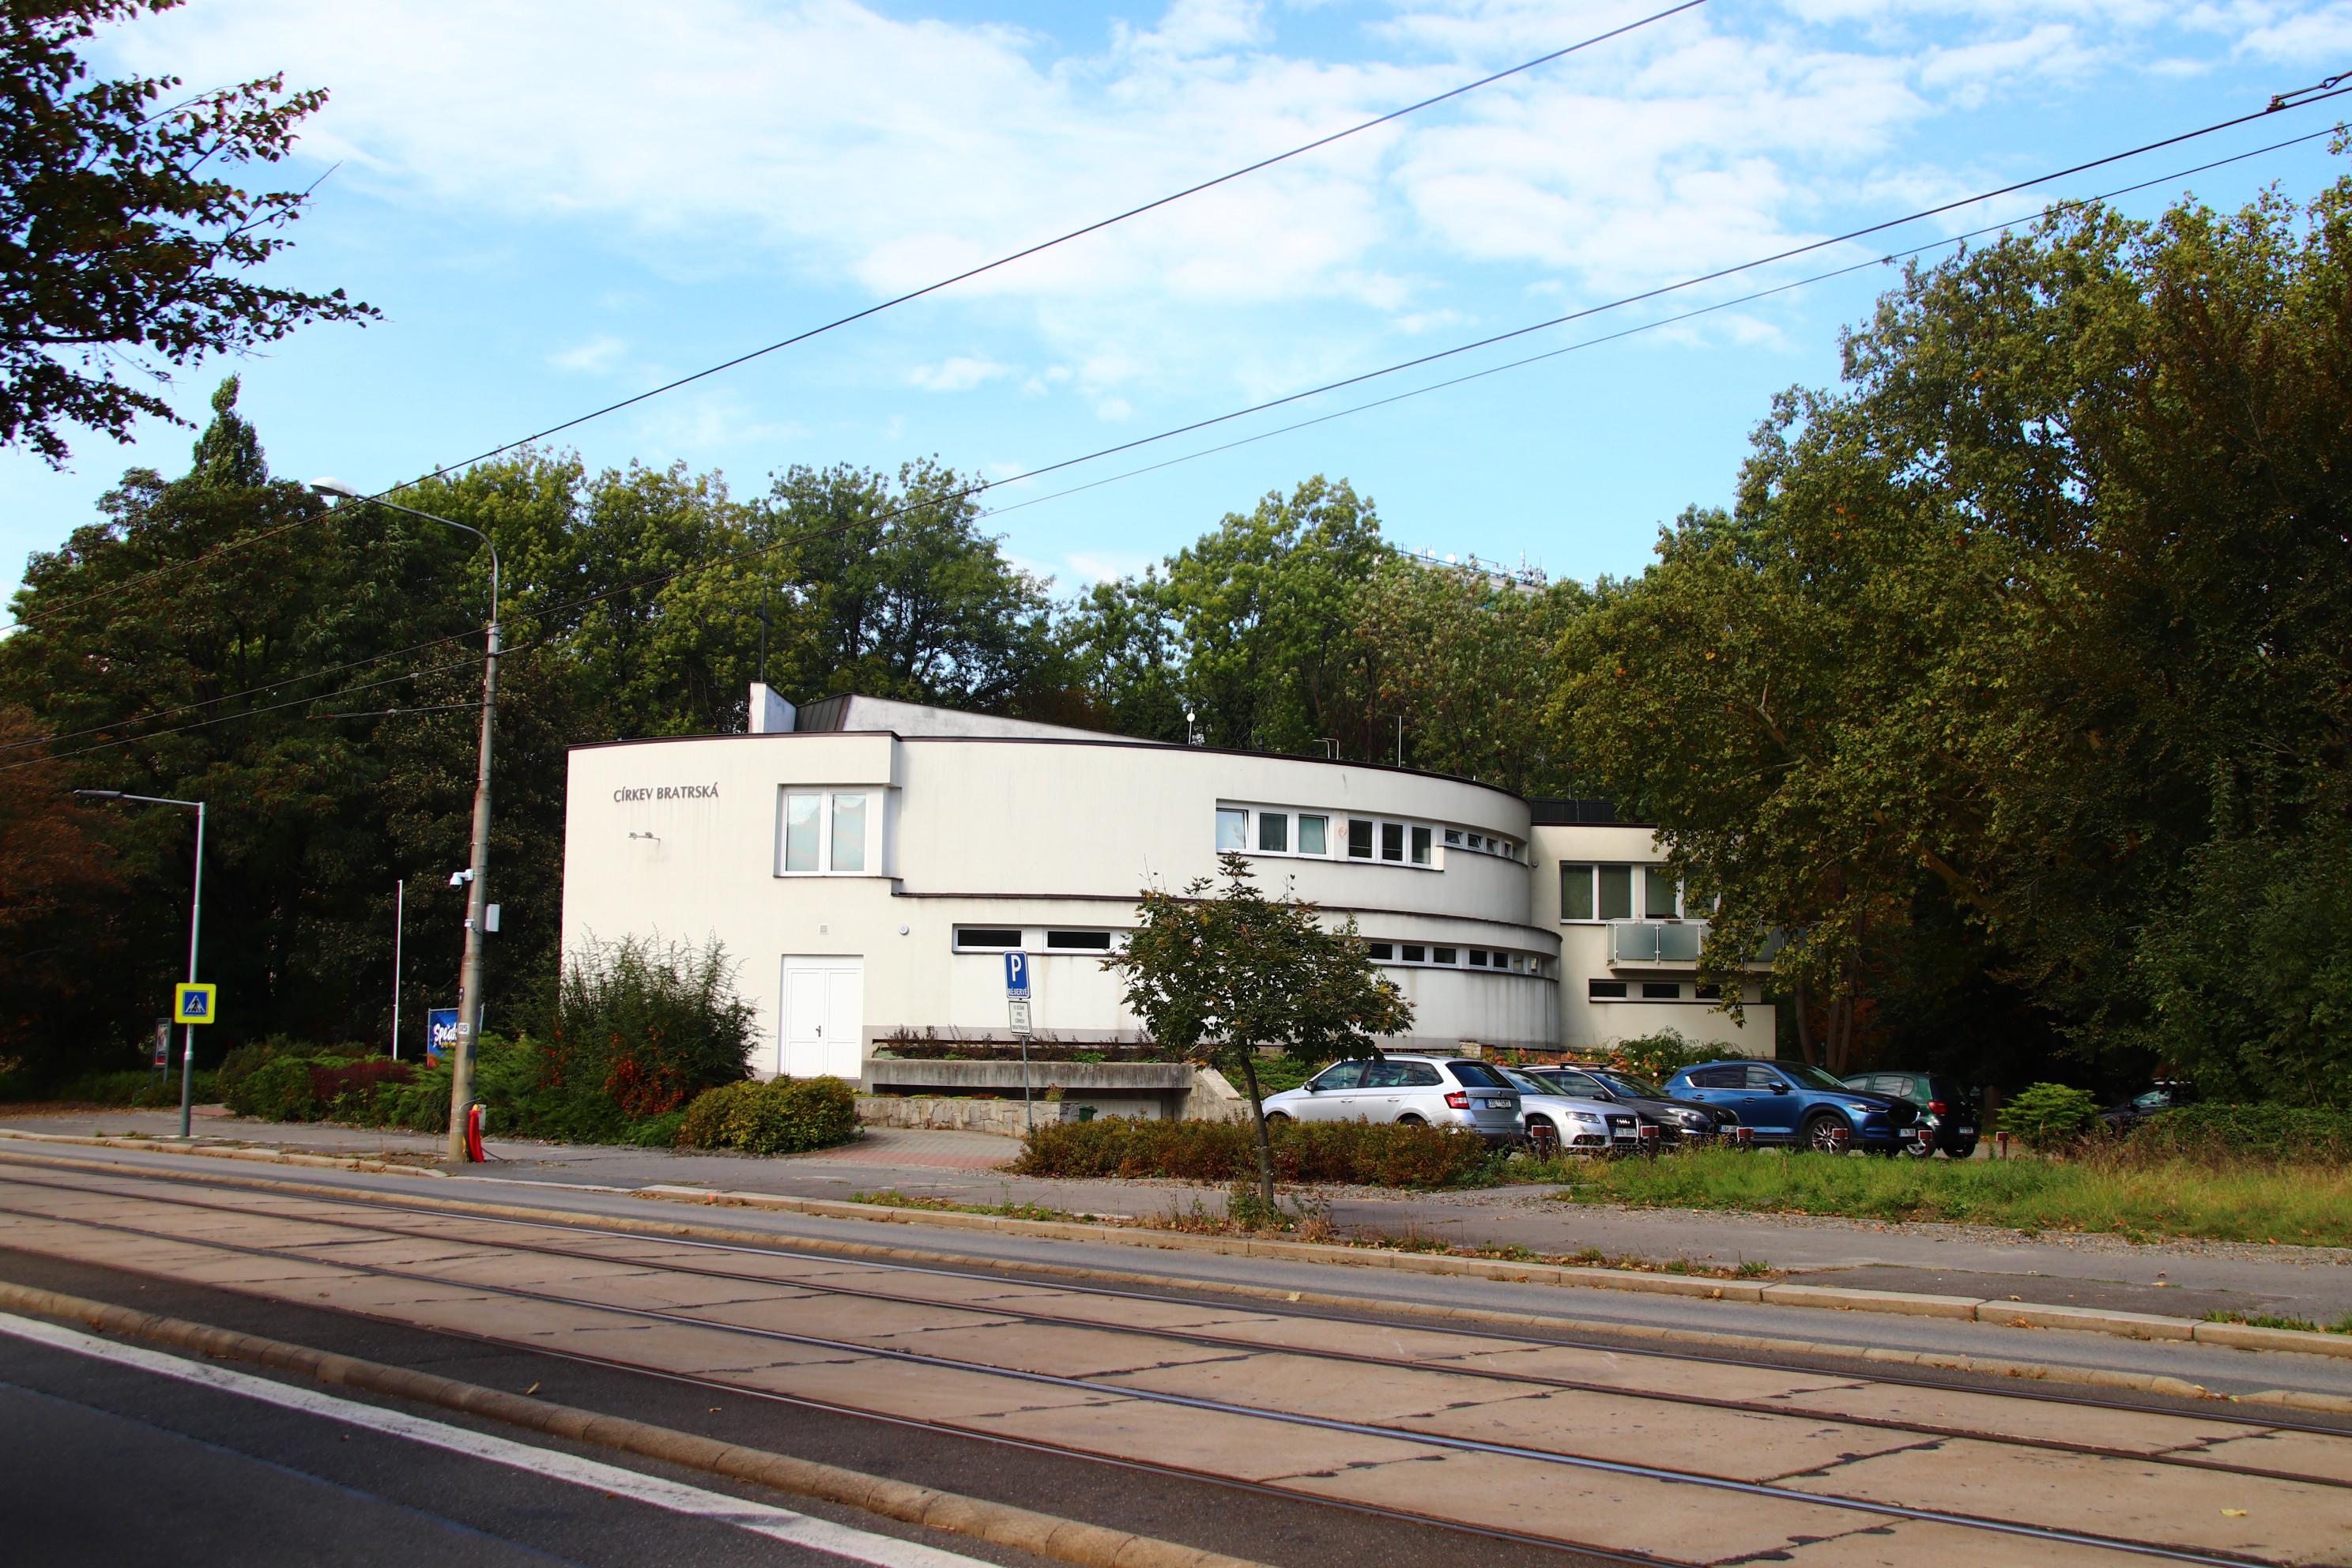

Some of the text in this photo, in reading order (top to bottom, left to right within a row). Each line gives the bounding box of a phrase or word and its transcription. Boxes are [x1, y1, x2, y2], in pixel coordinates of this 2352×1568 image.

[613, 782, 719, 802] CÍRKEV BRATRSKÁ
[1011, 955, 1022, 982] P
[1008, 986, 1028, 996] RÉSERVÉ
